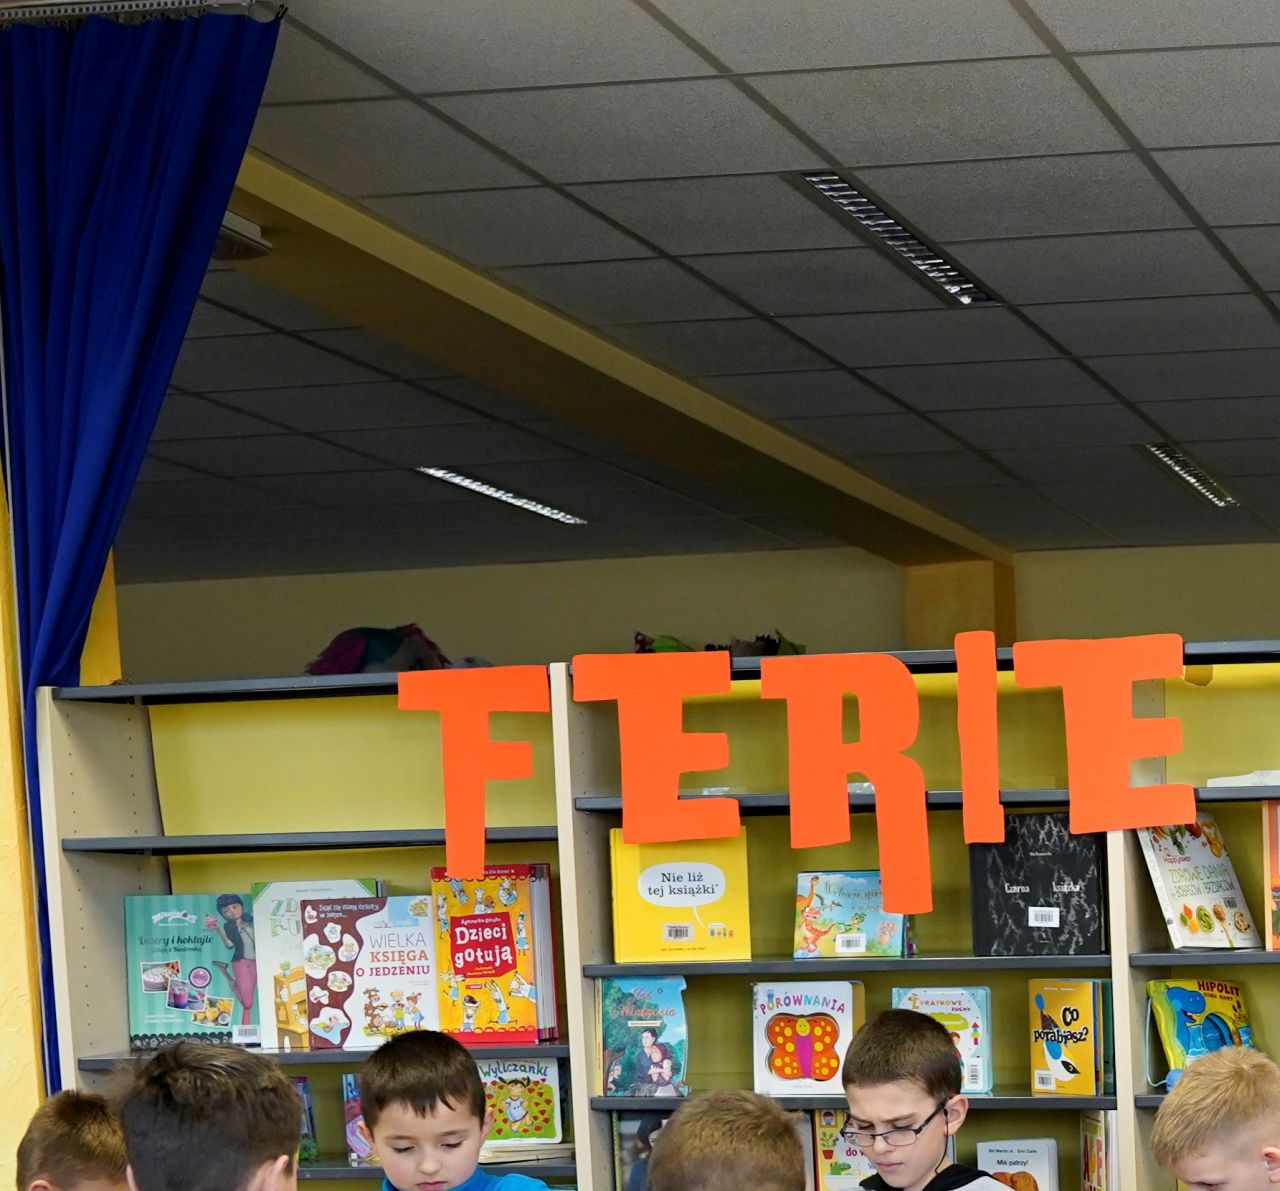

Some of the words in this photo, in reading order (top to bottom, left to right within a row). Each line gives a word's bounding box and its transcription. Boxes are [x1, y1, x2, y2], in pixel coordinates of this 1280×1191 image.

[397, 631, 1196, 914] FERIE
[660, 872, 684, 883] Nie
[687, 871, 704, 883] liż
[648, 884, 665, 897] tej
[1004, 882, 1030, 893] Czarna
[176, 934, 214, 946] koktajle
[369, 933, 427, 949] WIELKA
[454, 923, 507, 945] Dzieci
[369, 950, 429, 965] KSIĘGA
[454, 945, 513, 968] gotują
[355, 968, 365, 977] O
[369, 965, 431, 977] JEDZENIU
[1197, 980, 1241, 996] HIPOLIT
[759, 990, 846, 1015] PORÓWNANIA
[1061, 1005, 1080, 1027] Co
[1033, 1026, 1089, 1044] porabiasz?
[478, 1060, 549, 1078] Wyliczanki
[846, 1147, 858, 1157] do
[996, 1158, 1008, 1166] Miś
[1009, 1159, 1029, 1167] patrzy!
